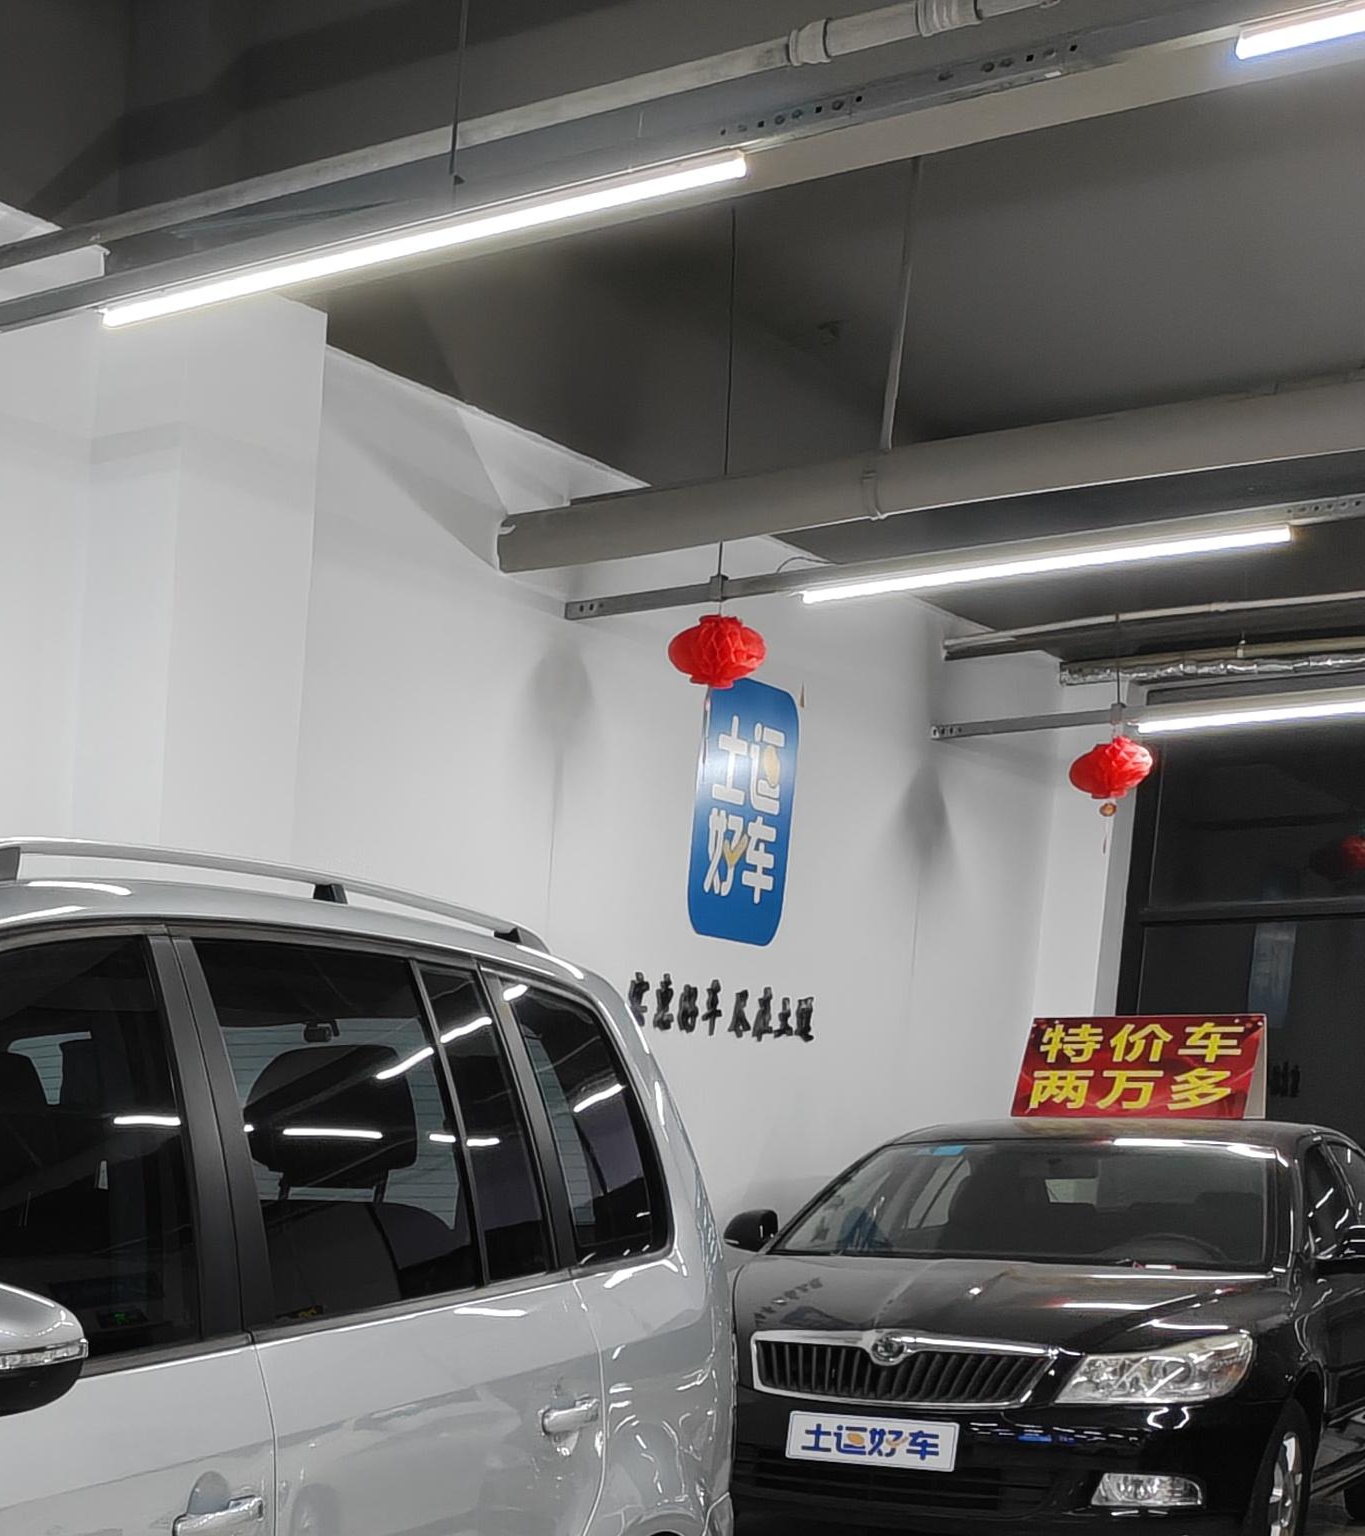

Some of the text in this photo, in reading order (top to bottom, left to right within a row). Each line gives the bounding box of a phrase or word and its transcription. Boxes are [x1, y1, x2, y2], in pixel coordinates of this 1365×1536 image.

[711, 715, 786, 816] 土运
[703, 807, 777, 904] 好车
[1039, 1022, 1245, 1063] 特价车
[1027, 1067, 1233, 1111] 两万多
[801, 1423, 940, 1460] 土运好车
